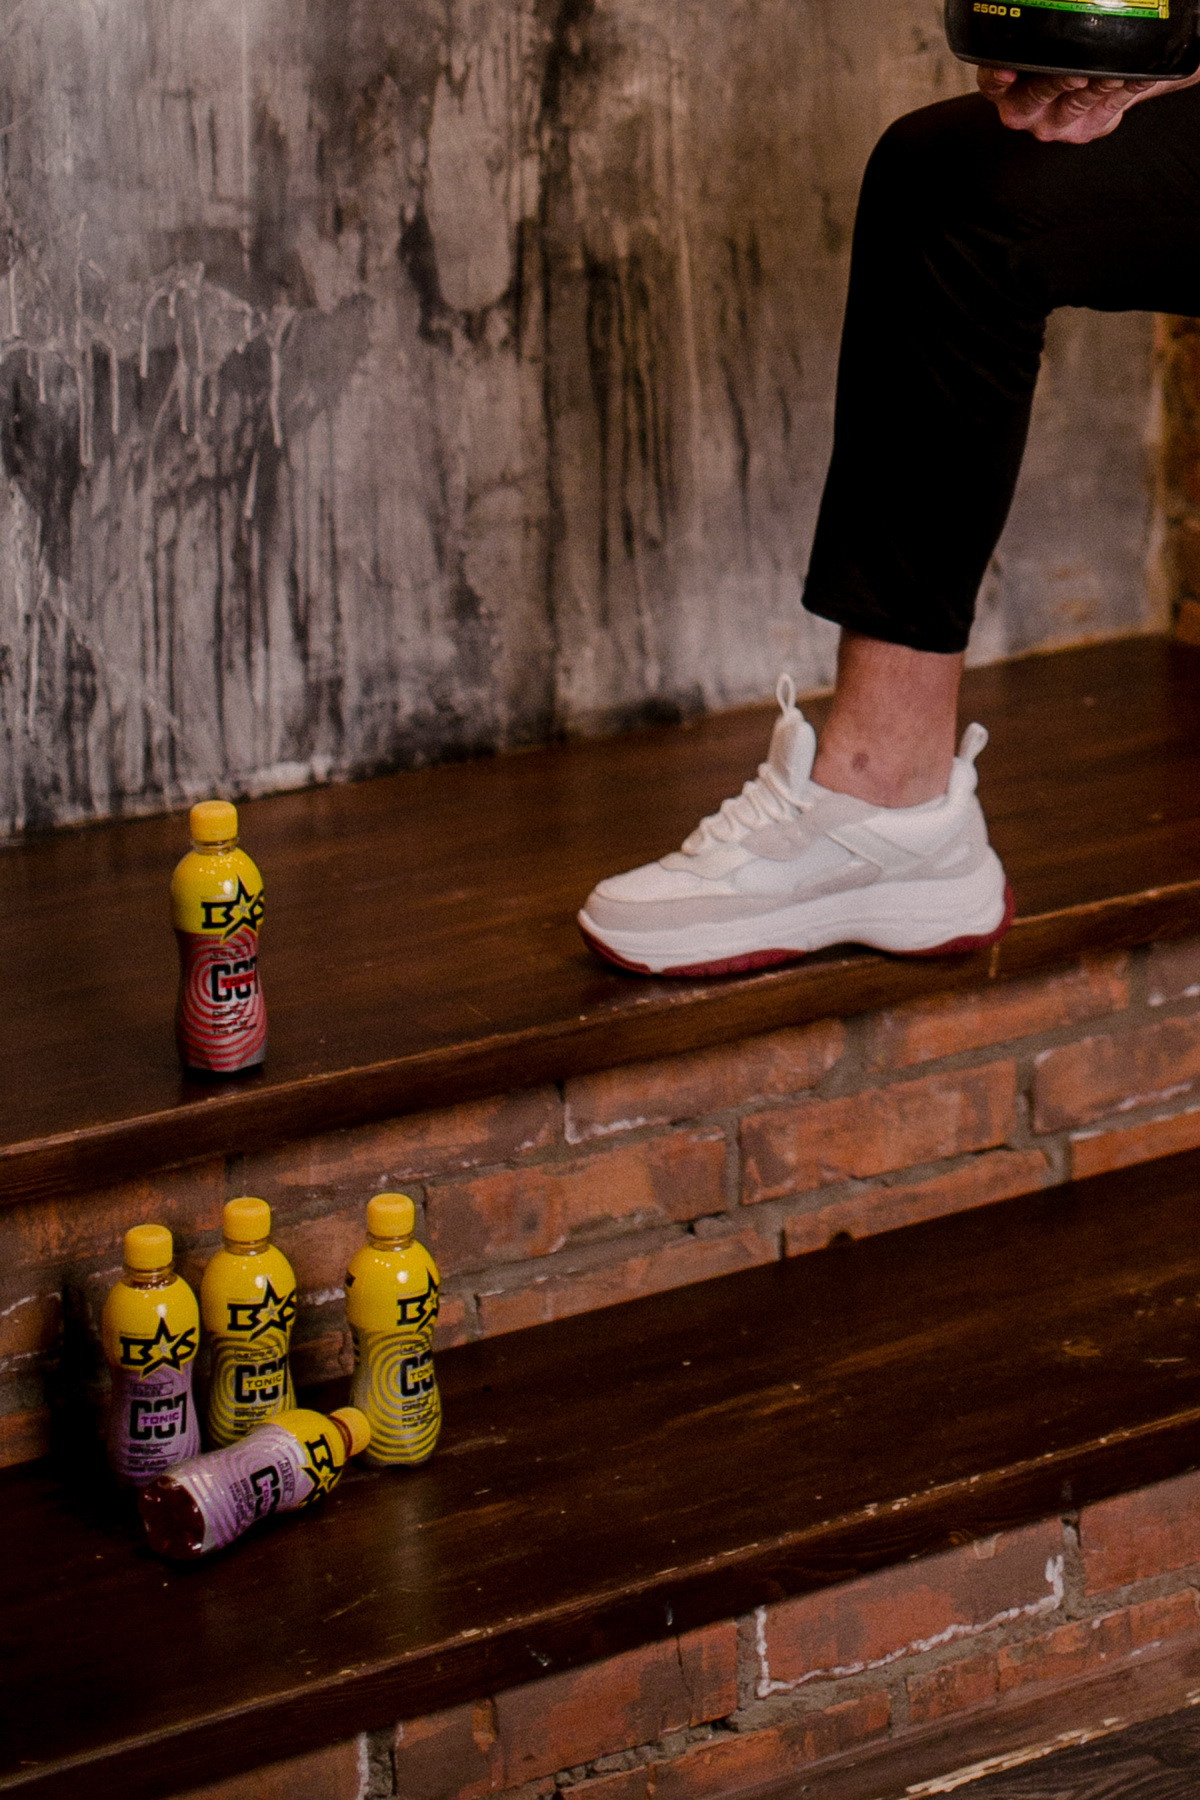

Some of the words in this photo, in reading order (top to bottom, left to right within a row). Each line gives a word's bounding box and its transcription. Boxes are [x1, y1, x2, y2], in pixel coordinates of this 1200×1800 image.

[973, 2, 1007, 16] 2500
[1010, 6, 1021, 18] G
[245, 1373, 282, 1389] TONIC
[141, 1411, 180, 1426] TONIC
